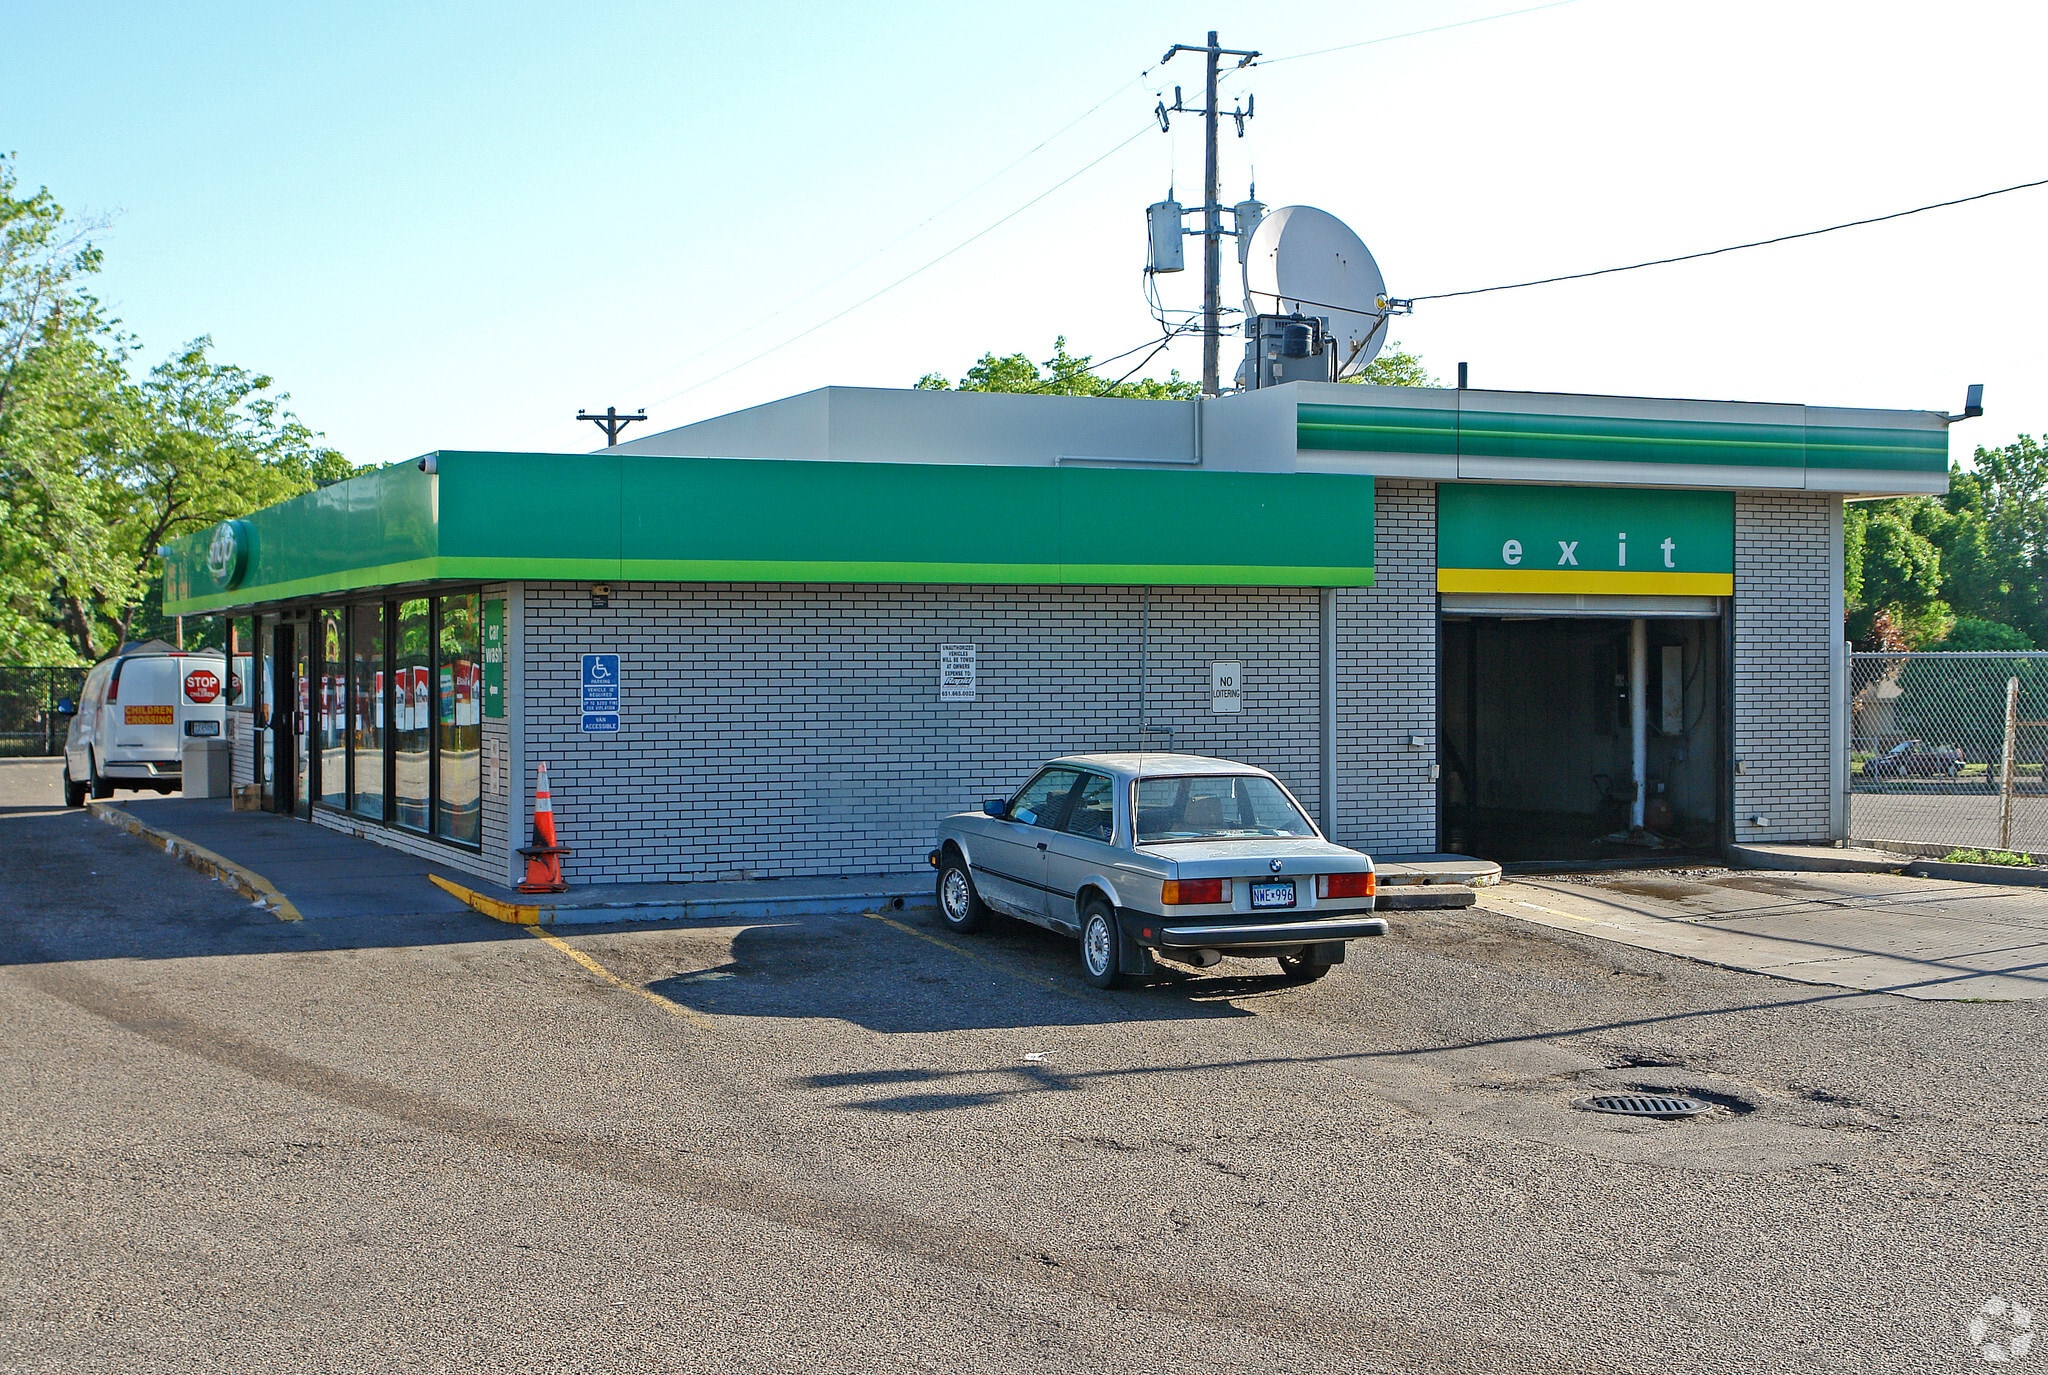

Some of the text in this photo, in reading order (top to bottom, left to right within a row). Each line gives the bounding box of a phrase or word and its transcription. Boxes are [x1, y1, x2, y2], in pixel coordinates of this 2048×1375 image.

[1502, 532, 1676, 568] exit
[489, 625, 499, 640] car
[486, 642, 502, 663] wash
[187, 677, 217, 688] STOP
[1220, 677, 1232, 686] NO
[1214, 690, 1240, 698] LOITERING
[126, 706, 172, 714] CHILDREN
[126, 716, 172, 724] CROSSING
